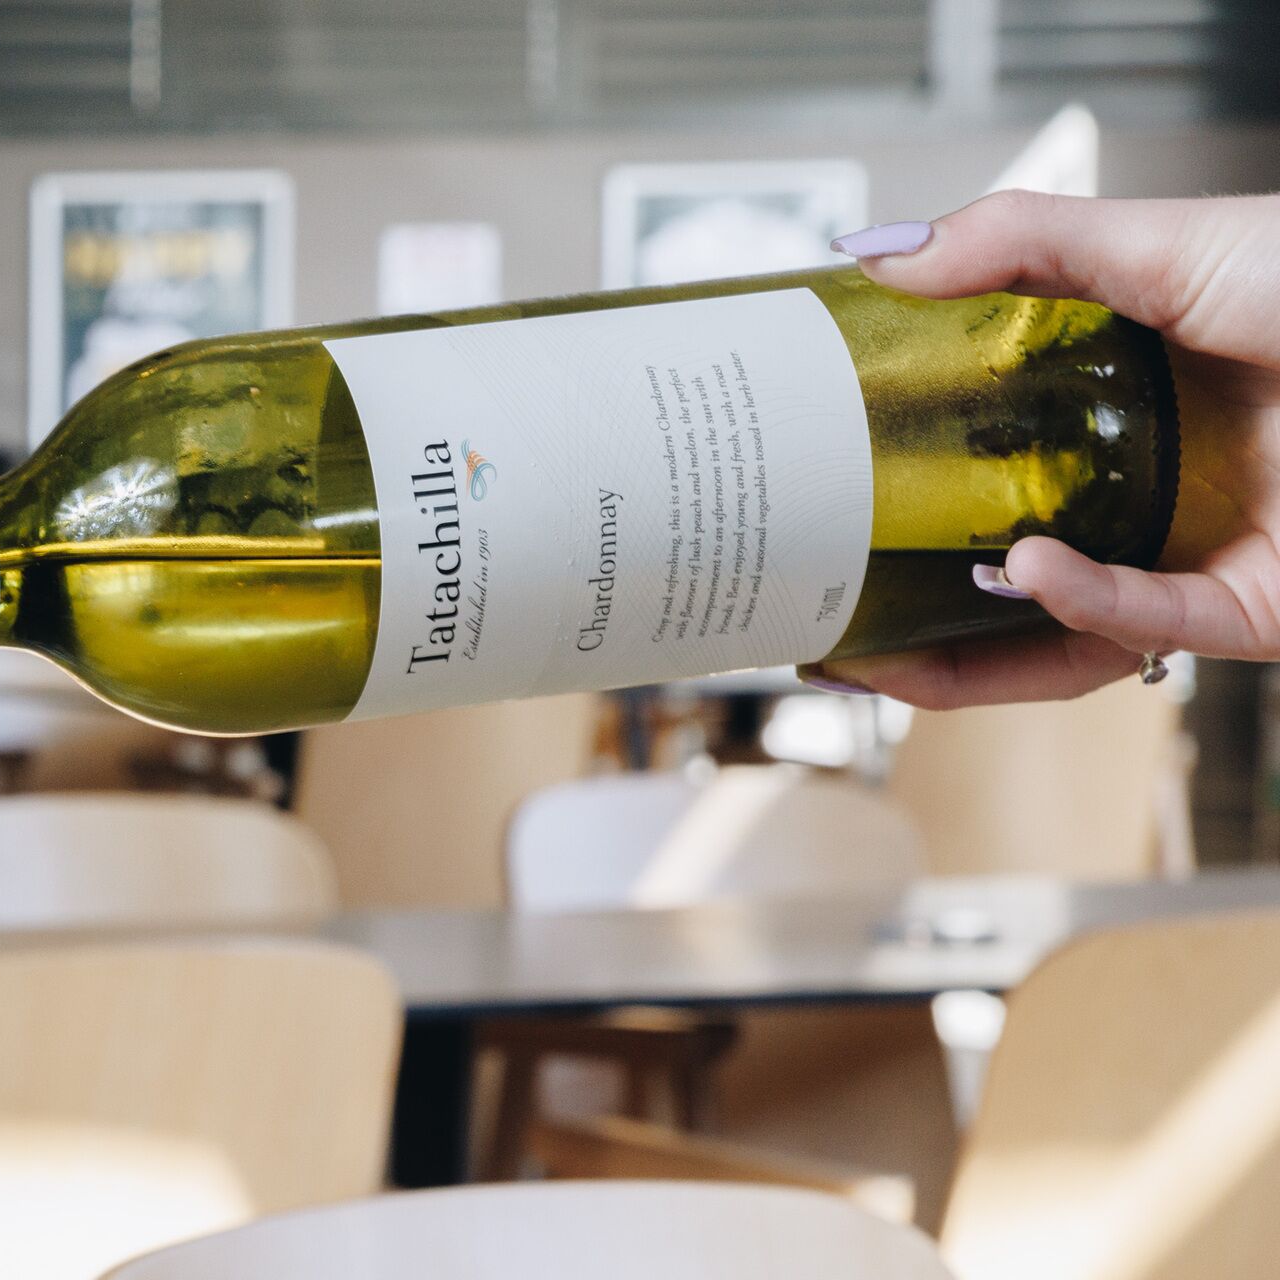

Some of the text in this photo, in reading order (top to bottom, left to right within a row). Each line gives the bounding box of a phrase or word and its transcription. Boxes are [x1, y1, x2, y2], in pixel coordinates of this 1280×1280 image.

[712, 364, 727, 388] roast
[722, 391, 730, 399] a
[738, 384, 755, 408] herb
[721, 401, 737, 427] with
[749, 411, 758, 424] in
[728, 431, 746, 464] fresh,
[748, 427, 765, 461] tossed
[731, 466, 744, 490] and
[754, 464, 771, 525] vegetables
[645, 365, 683, 643] Crisp and refreshing, this is a modern Chardonnay
[668, 368, 705, 640] with flavours of lush peach and melon, the perfect
[691, 376, 727, 638] accompaniment to an afternoon in the sun with
[738, 491, 749, 529] young
[406, 438, 462, 675] Tatachilla
[733, 531, 748, 575] enjoyed
[755, 527, 766, 573] seasonal
[577, 488, 624, 652] Chardonnay
[726, 577, 740, 598] Best
[750, 576, 761, 595] and
[463, 528, 492, 661] Established in 1903
[739, 597, 757, 633] chicken
